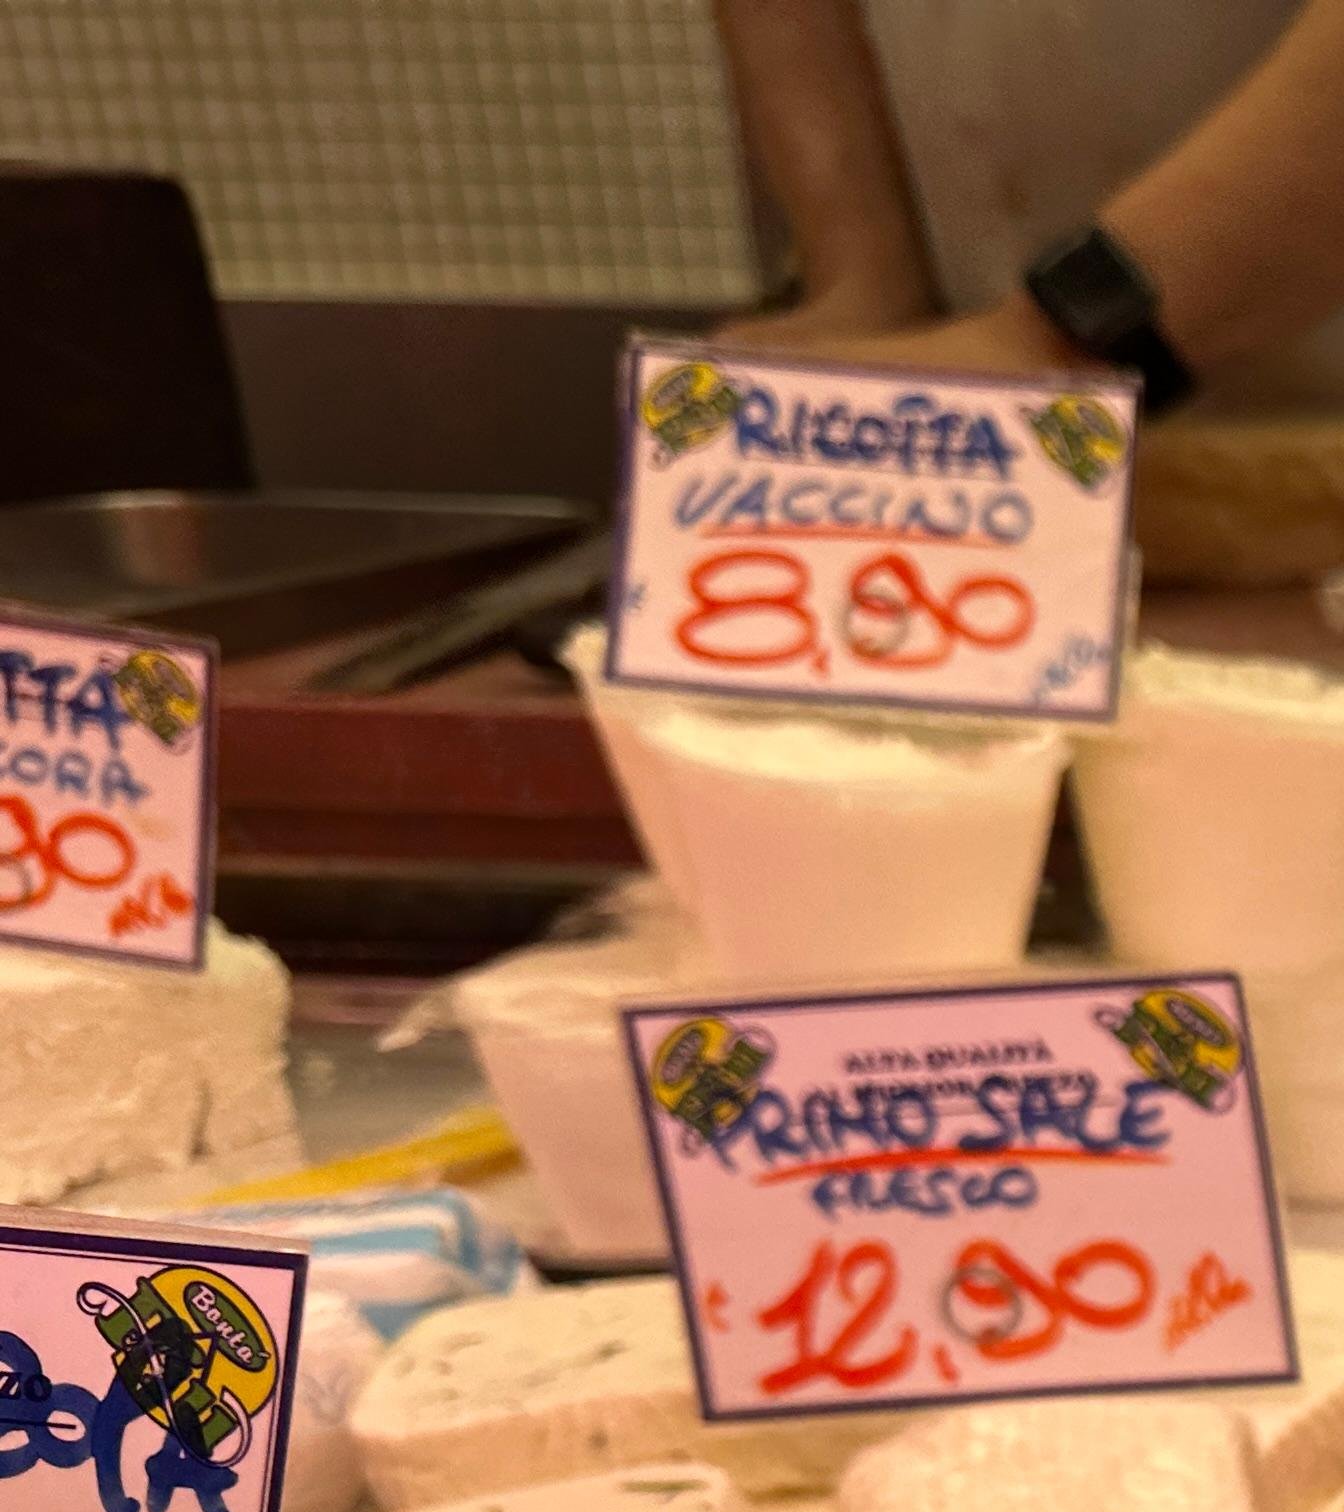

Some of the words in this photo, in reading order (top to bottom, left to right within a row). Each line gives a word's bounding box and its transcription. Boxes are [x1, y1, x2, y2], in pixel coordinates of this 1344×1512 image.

[735, 387, 1020, 480] RICOTTA
[676, 475, 1033, 545] VACCINO
[756, 1236, 1157, 1397] 12,90
